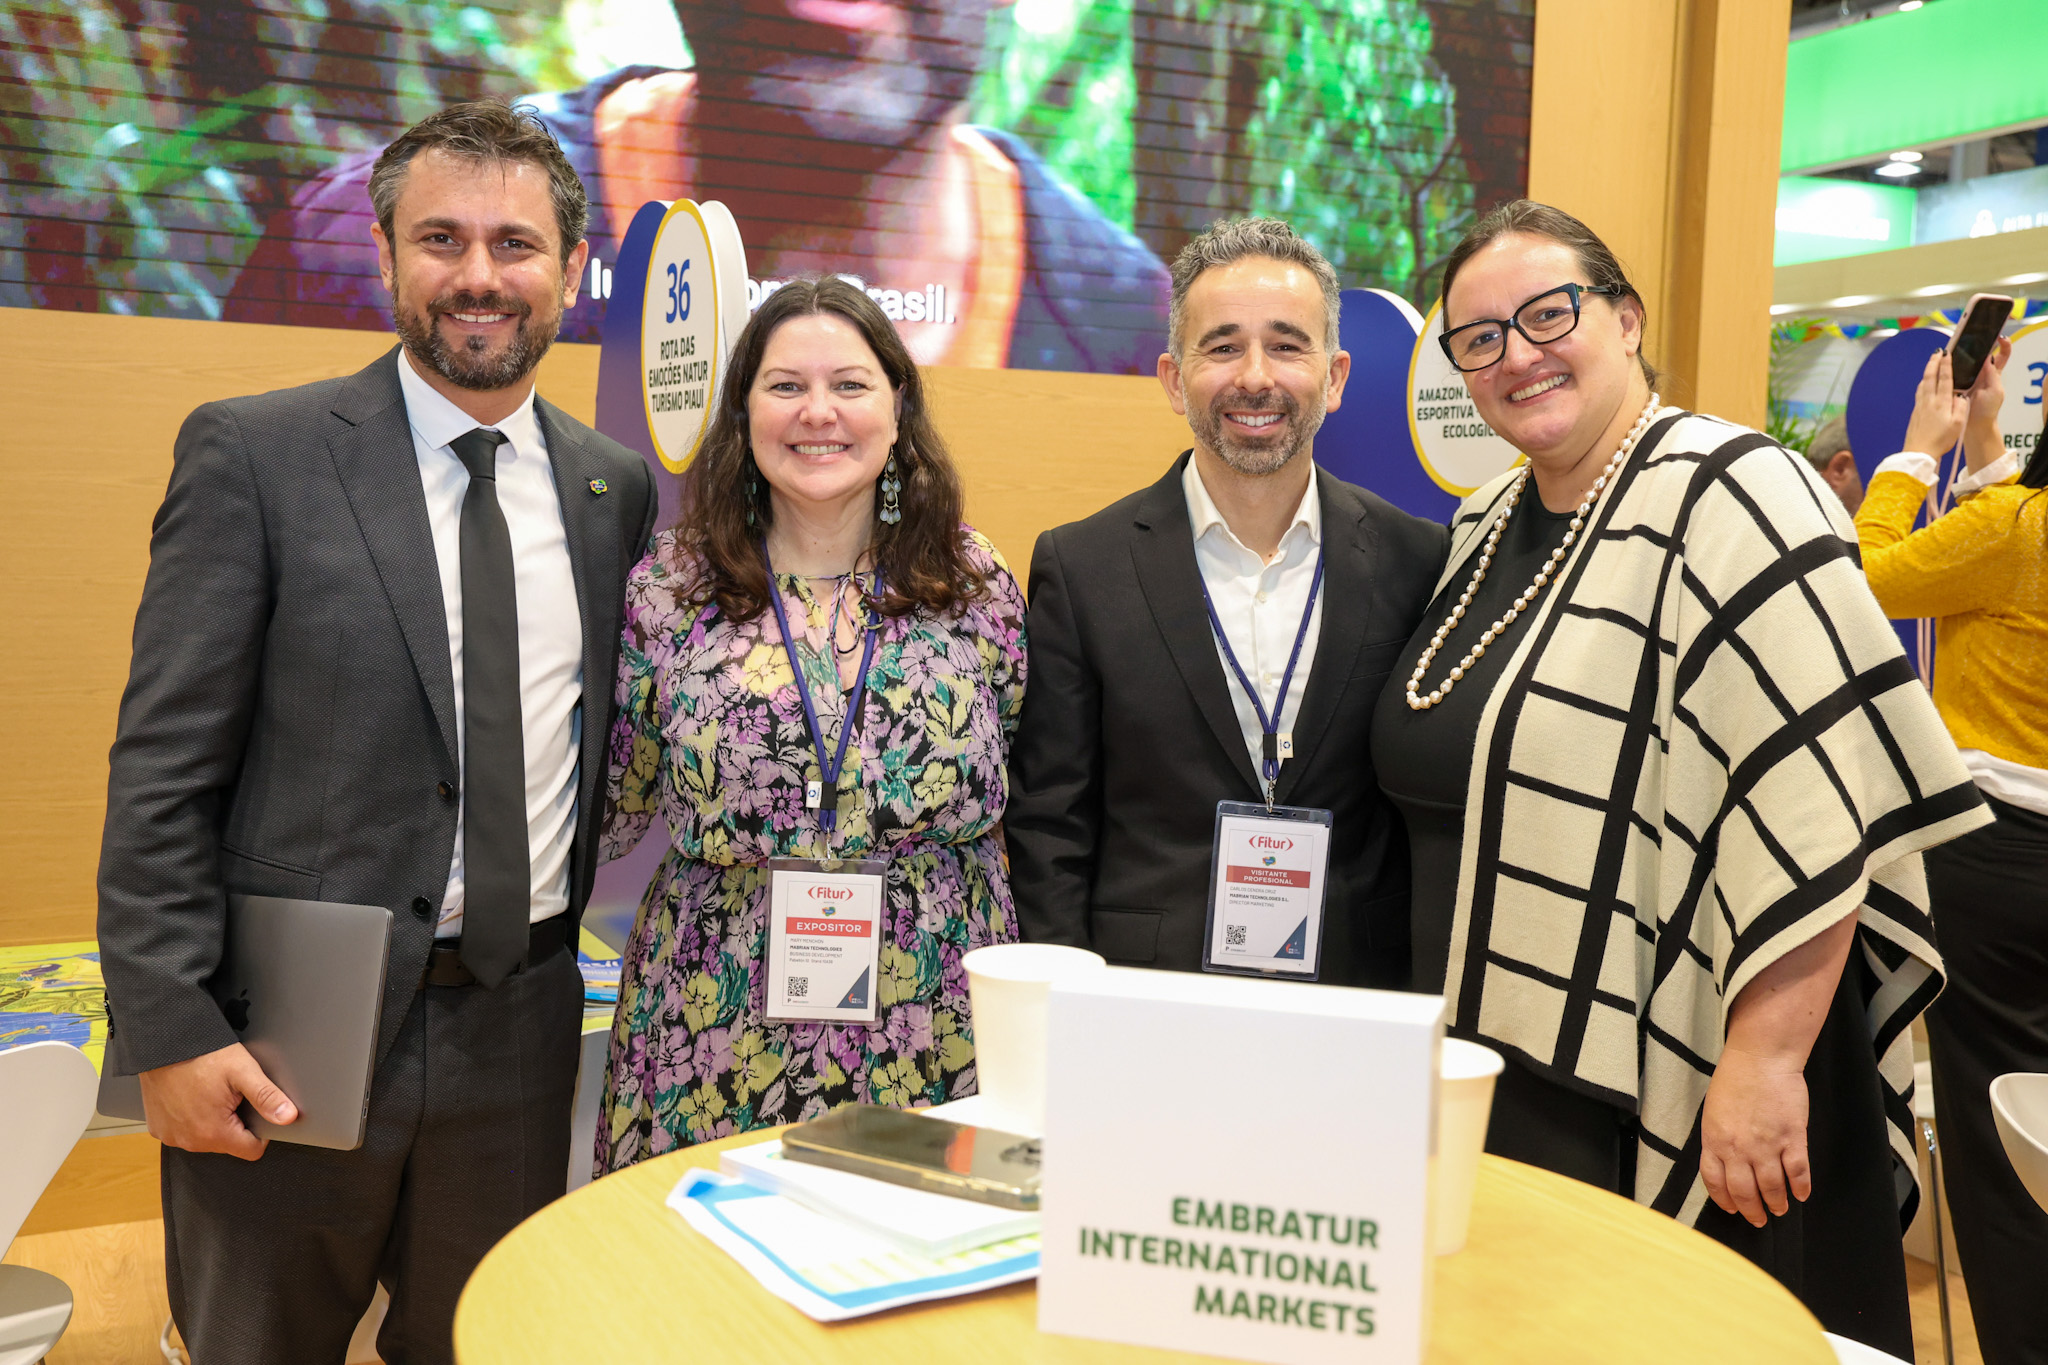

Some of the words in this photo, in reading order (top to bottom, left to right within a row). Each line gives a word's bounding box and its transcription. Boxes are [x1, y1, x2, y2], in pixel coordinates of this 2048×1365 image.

[666, 259, 691, 324] 36
[660, 338, 679, 360] ROTA
[680, 335, 695, 358] DAS
[649, 361, 682, 391] EMOÇÕES
[683, 360, 708, 383] NATUR
[652, 390, 683, 413] TURISMO
[684, 382, 704, 410] PIAUÍ
[1418, 386, 1464, 402] AMAZON
[1417, 404, 1474, 420] ESPORTIVA
[1443, 423, 1500, 438] ECOLOGIC
[1258, 836, 1286, 849] Fitur
[1243, 875, 1294, 885] PROFESIONAL
[1250, 869, 1288, 878] VISITANTE
[817, 887, 846, 899] Fitur
[796, 922, 862, 933] EXPOSITOR
[1172, 1197, 1379, 1249] EMBRATUR
[1080, 1228, 1379, 1294] INTERNATIONAL
[1194, 1285, 1377, 1338] MARKETS
